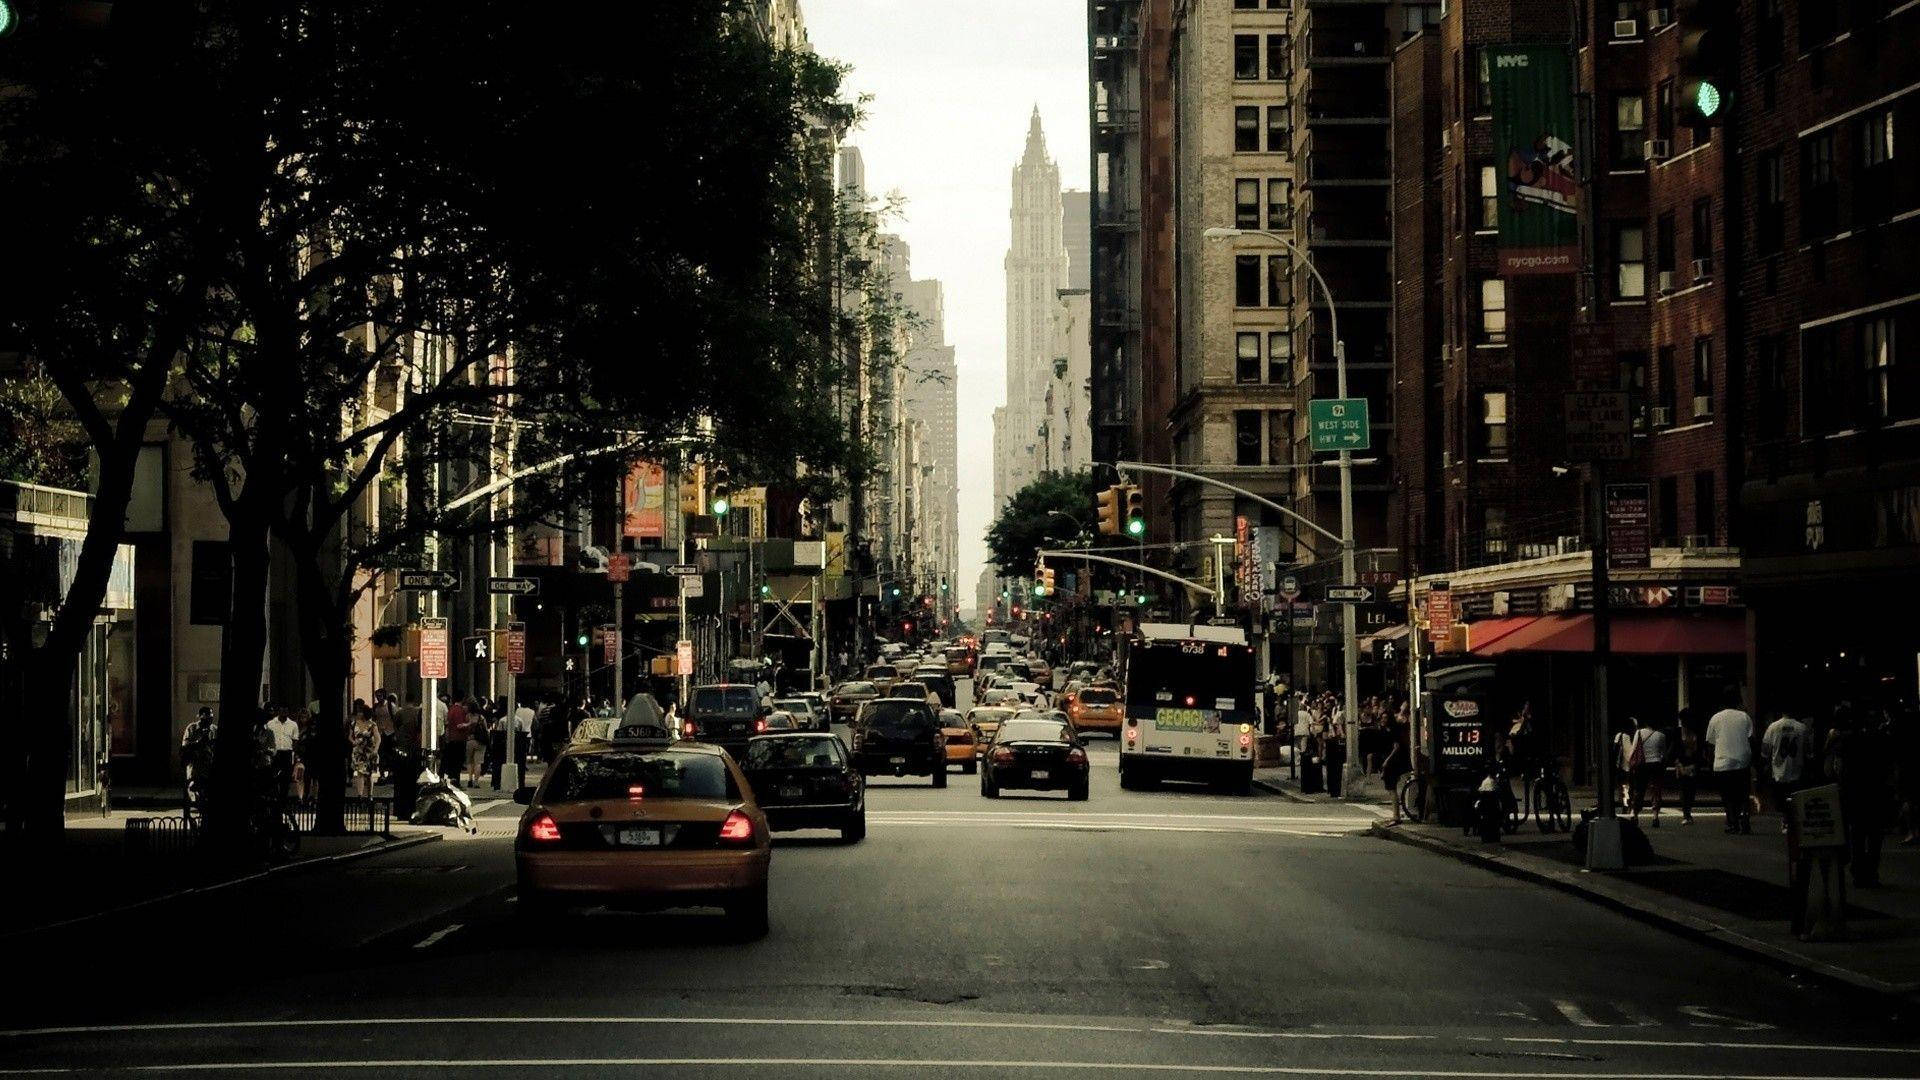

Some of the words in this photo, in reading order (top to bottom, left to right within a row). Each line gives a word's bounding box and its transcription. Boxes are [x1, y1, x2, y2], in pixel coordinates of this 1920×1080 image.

[1496, 54, 1529, 68] NYC
[1507, 254, 1570, 270] nycgo.com
[1317, 420, 1339, 430] WEST
[1341, 420, 1360, 430] SIDE
[1319, 434, 1337, 444] HWY
[408, 576, 427, 585] ONE
[1361, 573, 1367, 583] E
[1373, 574, 1379, 583] 9
[494, 580, 508, 589] ONE
[516, 580, 531, 589] WAY
[1332, 590, 1348, 598] ONE
[1353, 590, 1368, 598] WAY
[1182, 645, 1205, 655] 6738
[1458, 729, 1480, 743] 113
[1442, 746, 1483, 756] MILLION
